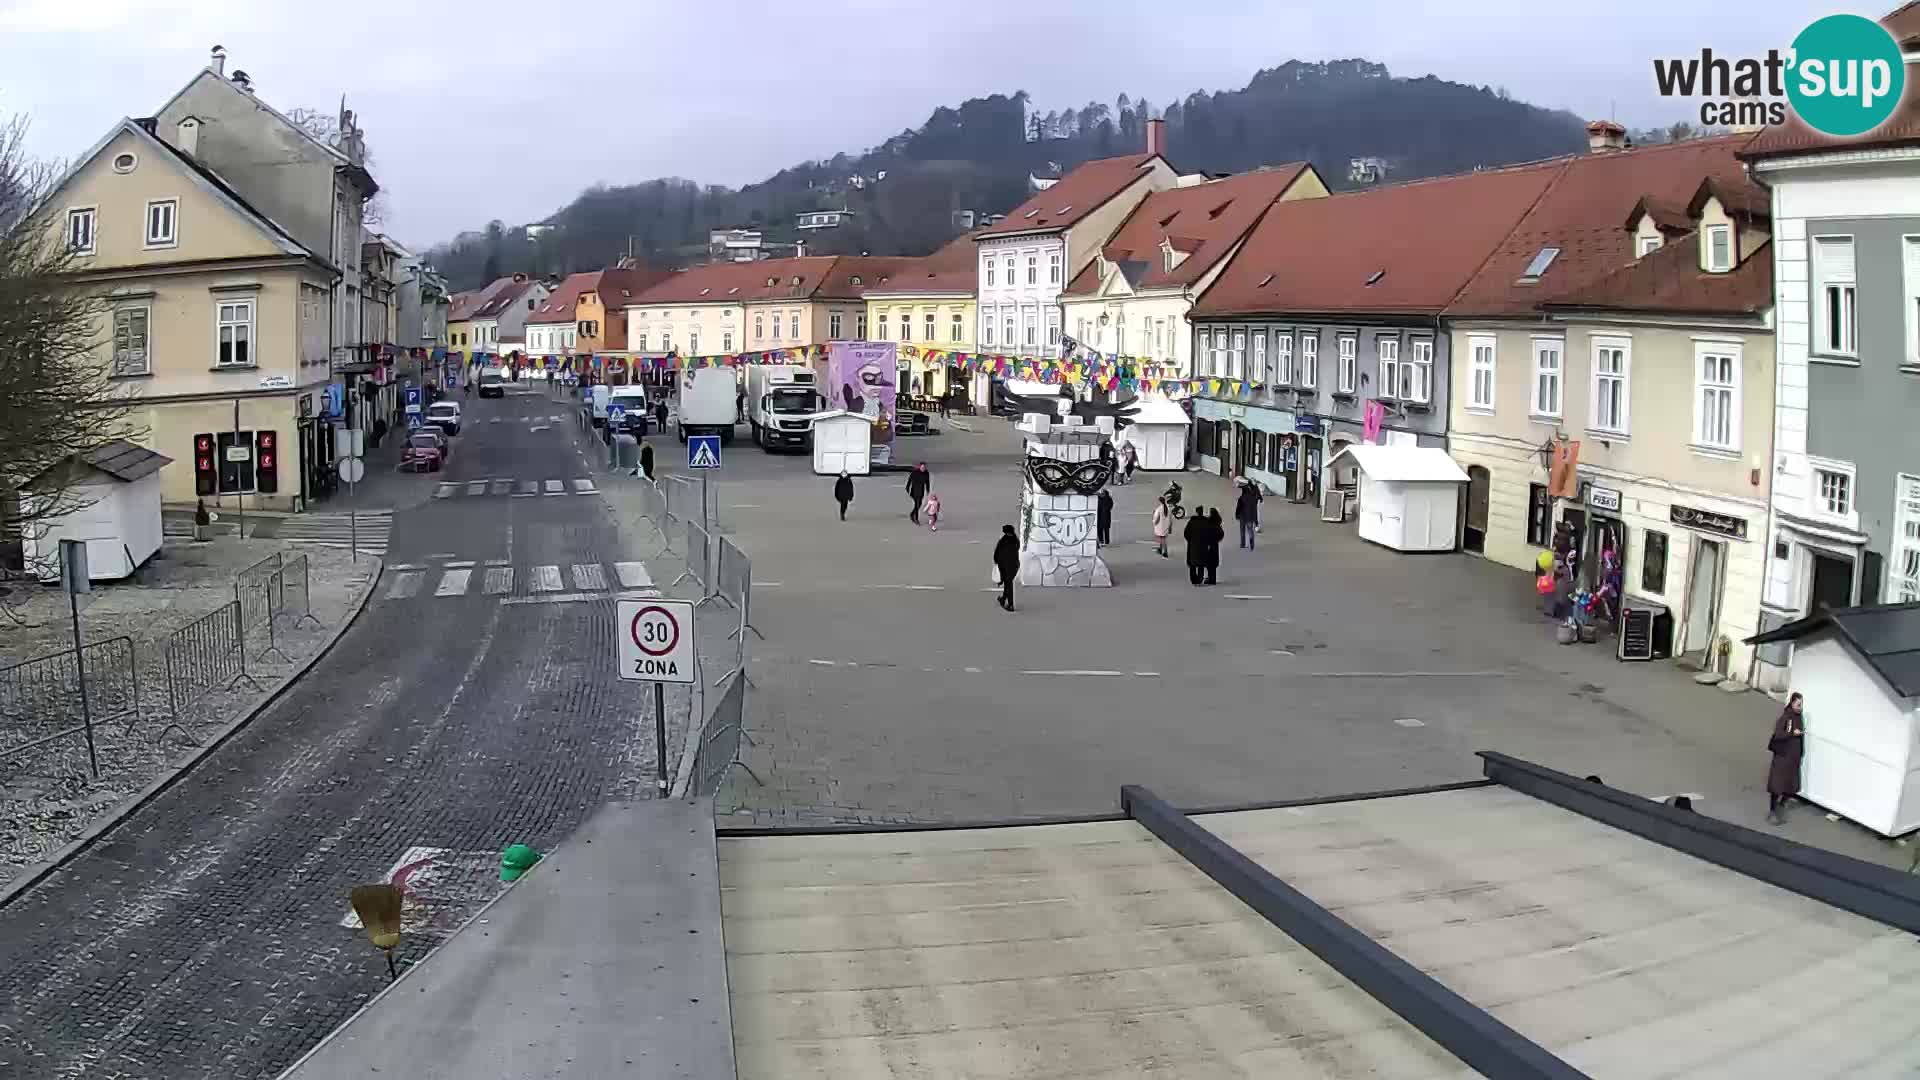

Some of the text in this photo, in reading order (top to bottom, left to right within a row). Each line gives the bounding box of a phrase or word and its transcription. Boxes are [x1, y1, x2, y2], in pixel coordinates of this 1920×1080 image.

[409, 391, 417, 402] P
[1047, 515, 1087, 546] 200
[643, 621, 668, 643] 30
[634, 658, 678, 675] ZONA
